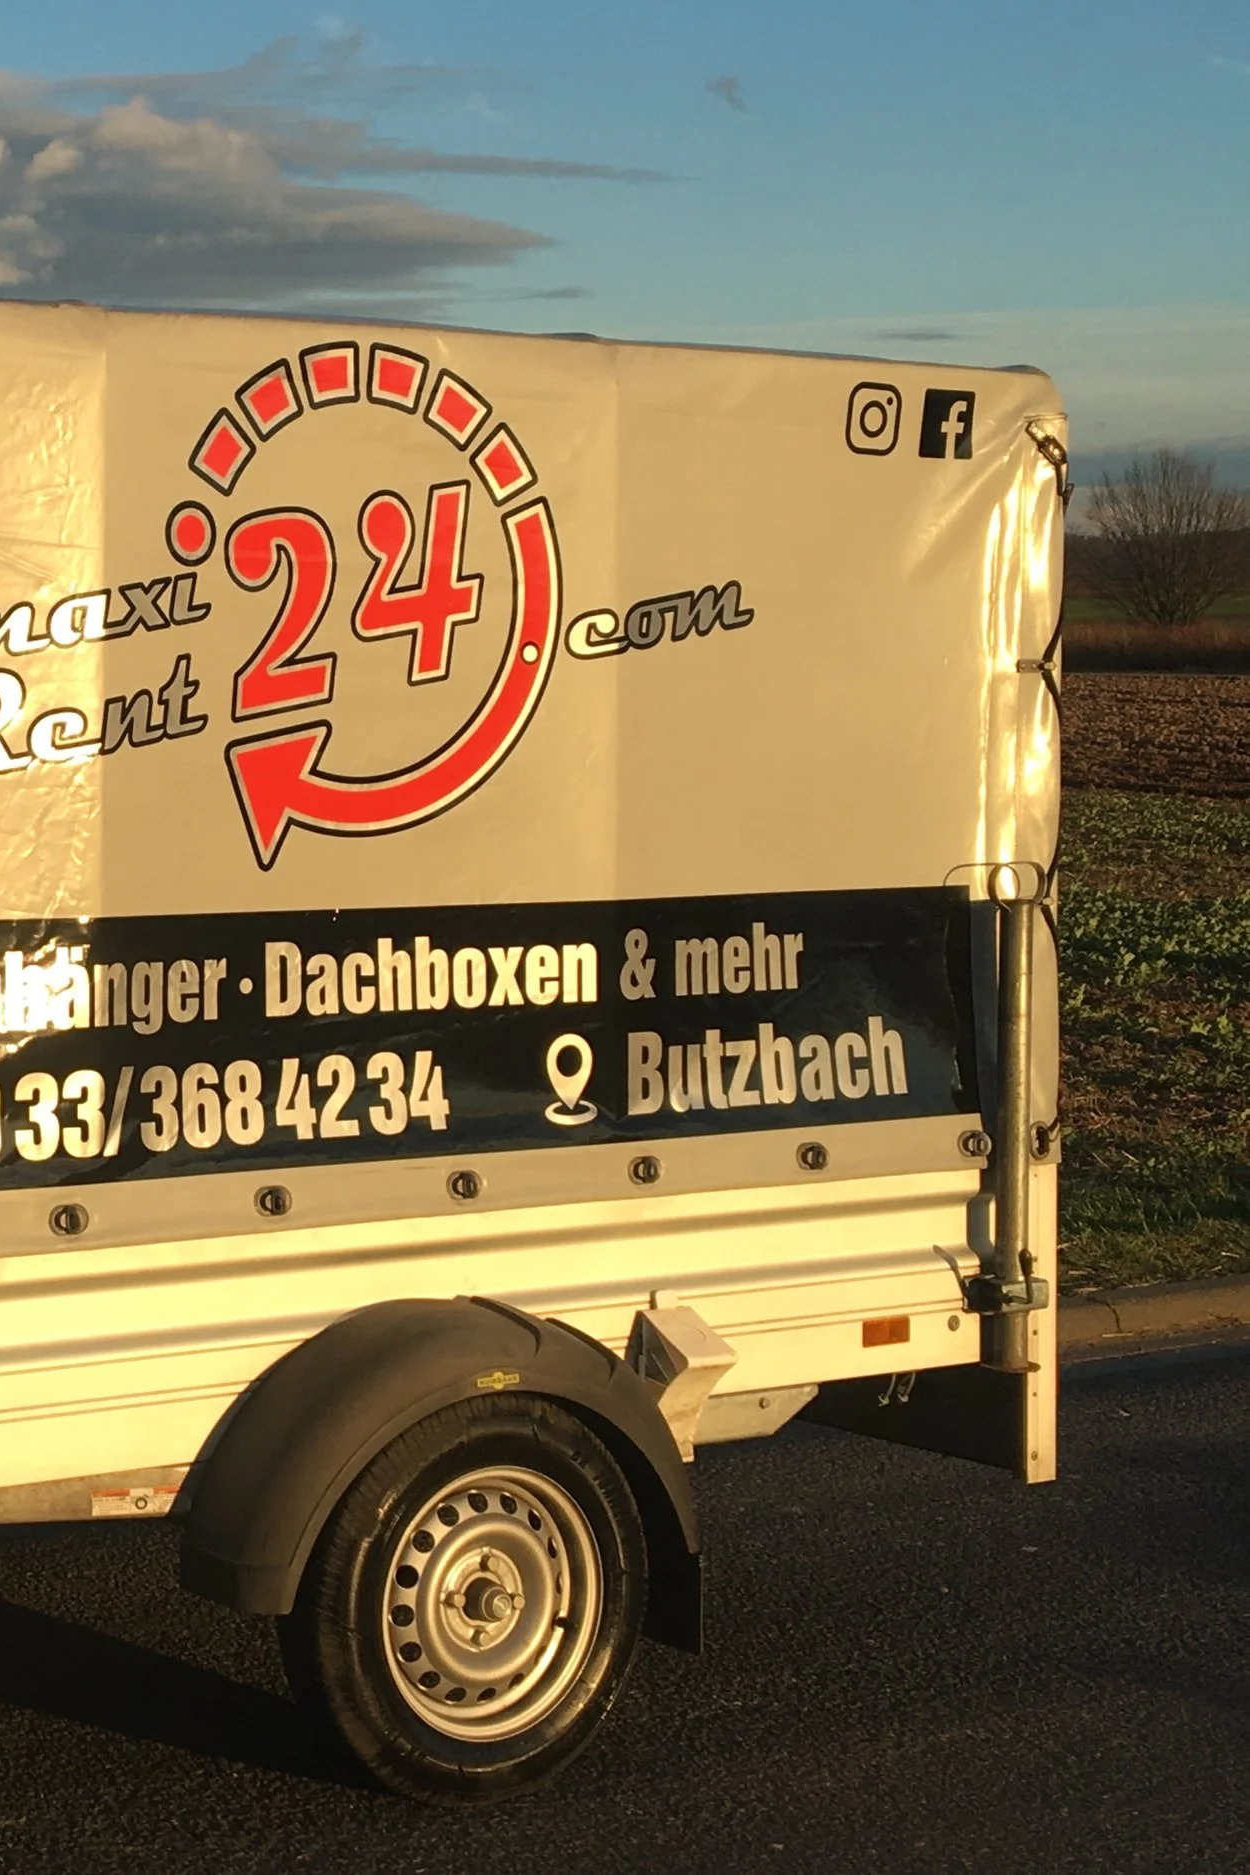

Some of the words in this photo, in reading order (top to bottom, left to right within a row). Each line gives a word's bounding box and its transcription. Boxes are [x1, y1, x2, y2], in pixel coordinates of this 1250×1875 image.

[225, 480, 484, 723] 24
[265, 938, 597, 1017] Dachboxen
[619, 928, 657, 1000] &
[674, 922, 804, 996] mehr
[628, 1017, 907, 1115] Butzbach
